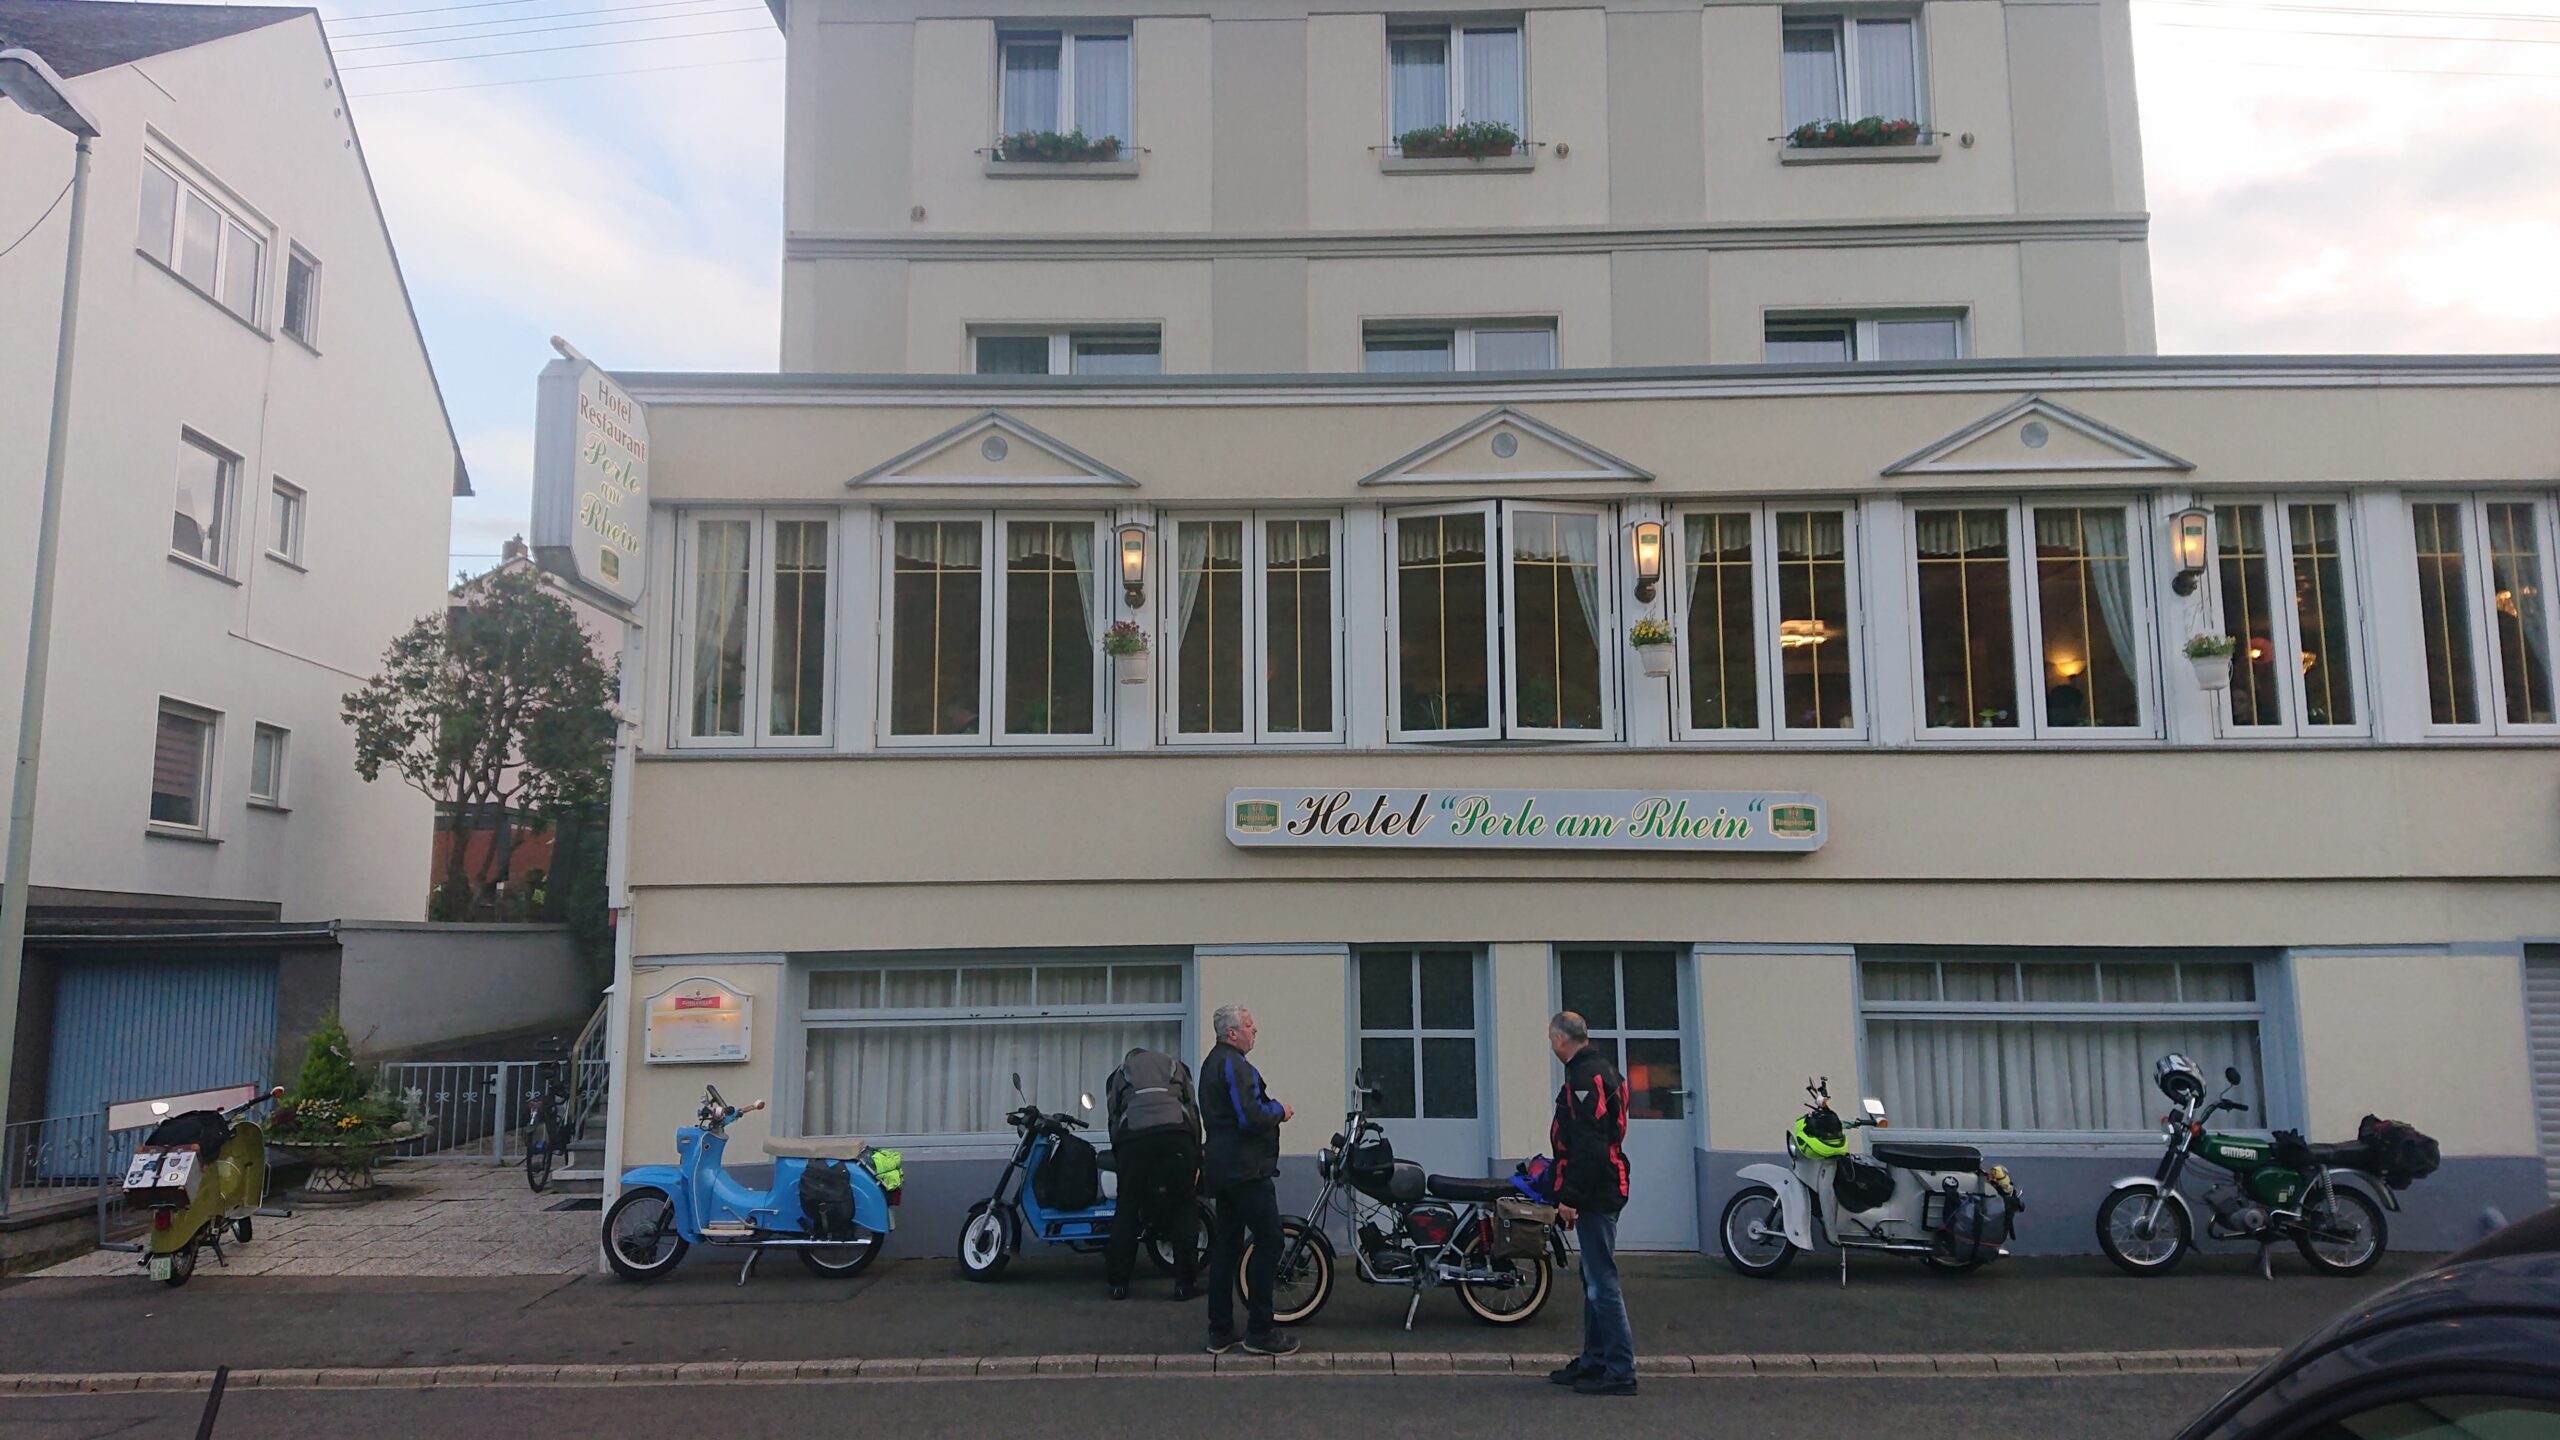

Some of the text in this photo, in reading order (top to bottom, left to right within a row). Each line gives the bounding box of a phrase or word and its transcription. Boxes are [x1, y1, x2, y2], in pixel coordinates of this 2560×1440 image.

[580, 393, 645, 463] Restaurant
[598, 379, 632, 425] Hotel
[583, 431, 640, 496] Perle
[601, 481, 621, 506] am
[580, 491, 639, 556] Rhein
[1287, 791, 1434, 836] Hotel
[1556, 814, 1625, 838] am
